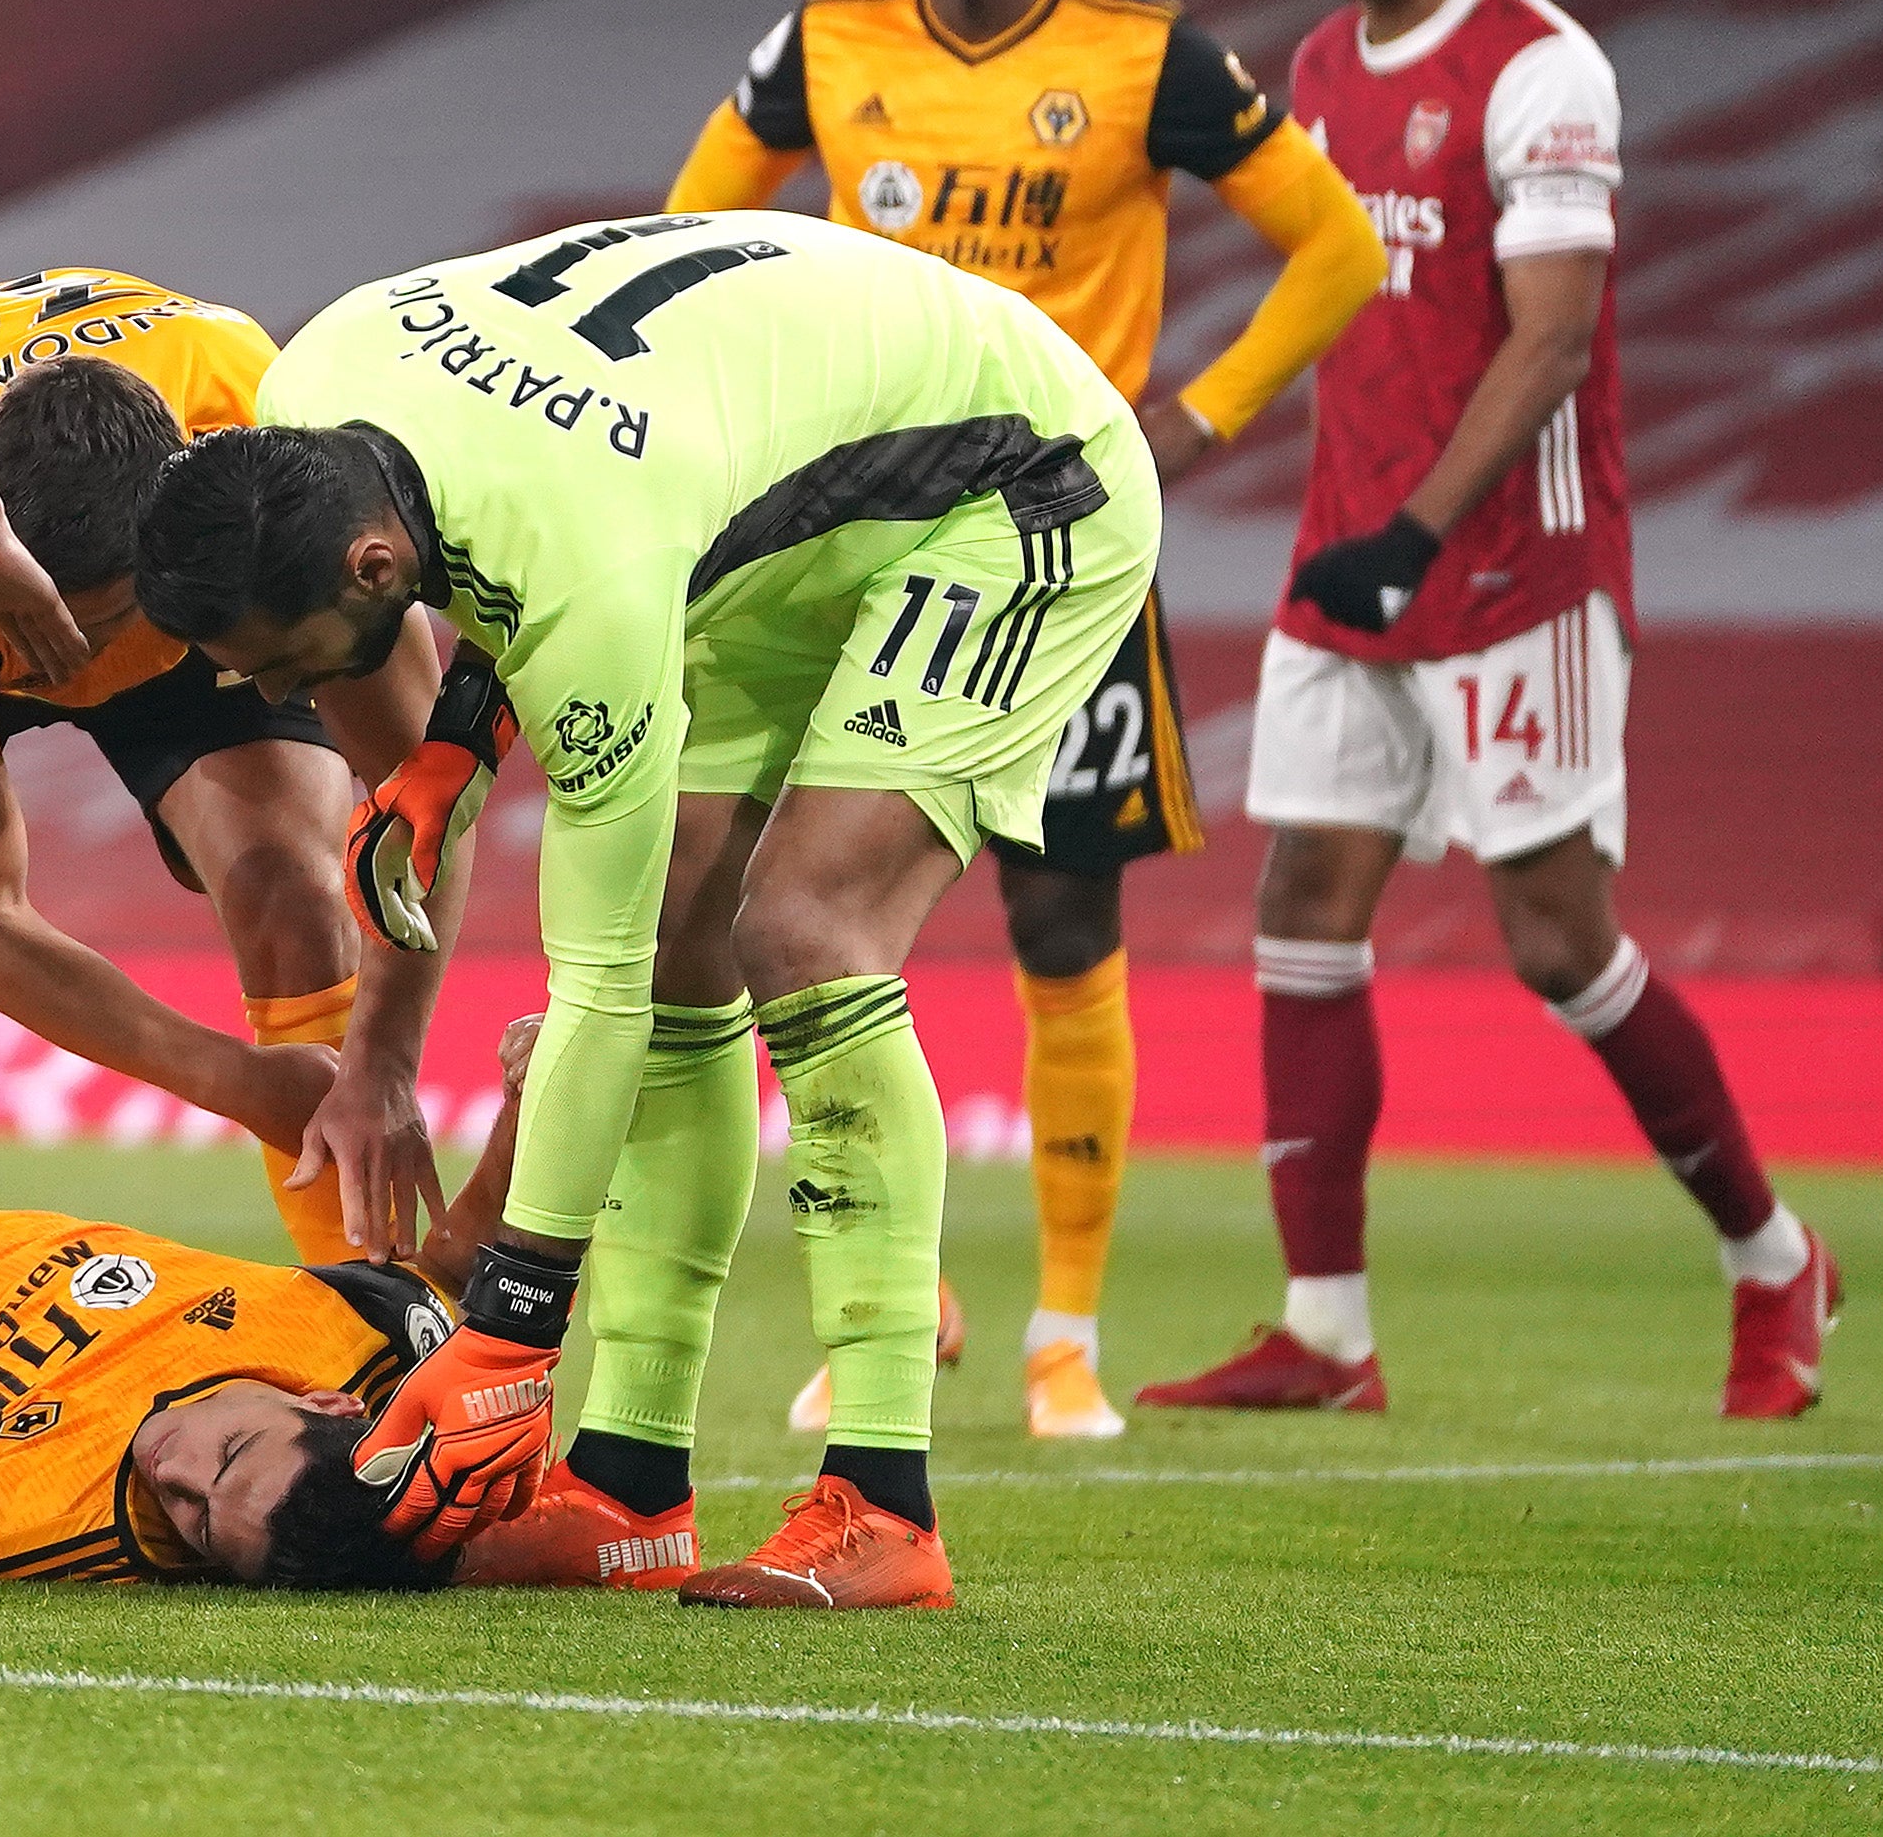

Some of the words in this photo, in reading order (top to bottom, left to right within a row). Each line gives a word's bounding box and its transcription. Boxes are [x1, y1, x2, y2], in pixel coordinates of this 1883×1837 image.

[491, 215, 791, 362] 11
[869, 573, 982, 697] 11
[843, 717, 909, 749] adidas
[1047, 681, 1151, 798] 22
[1456, 673, 1547, 763] 14
[183, 1286, 235, 1325] adidas
[498, 1277, 555, 1304] PATRICIO
[509, 1297, 534, 1315] RUI
[462, 1372, 552, 1424] PUMA
[596, 1531, 695, 1578] PUMA
